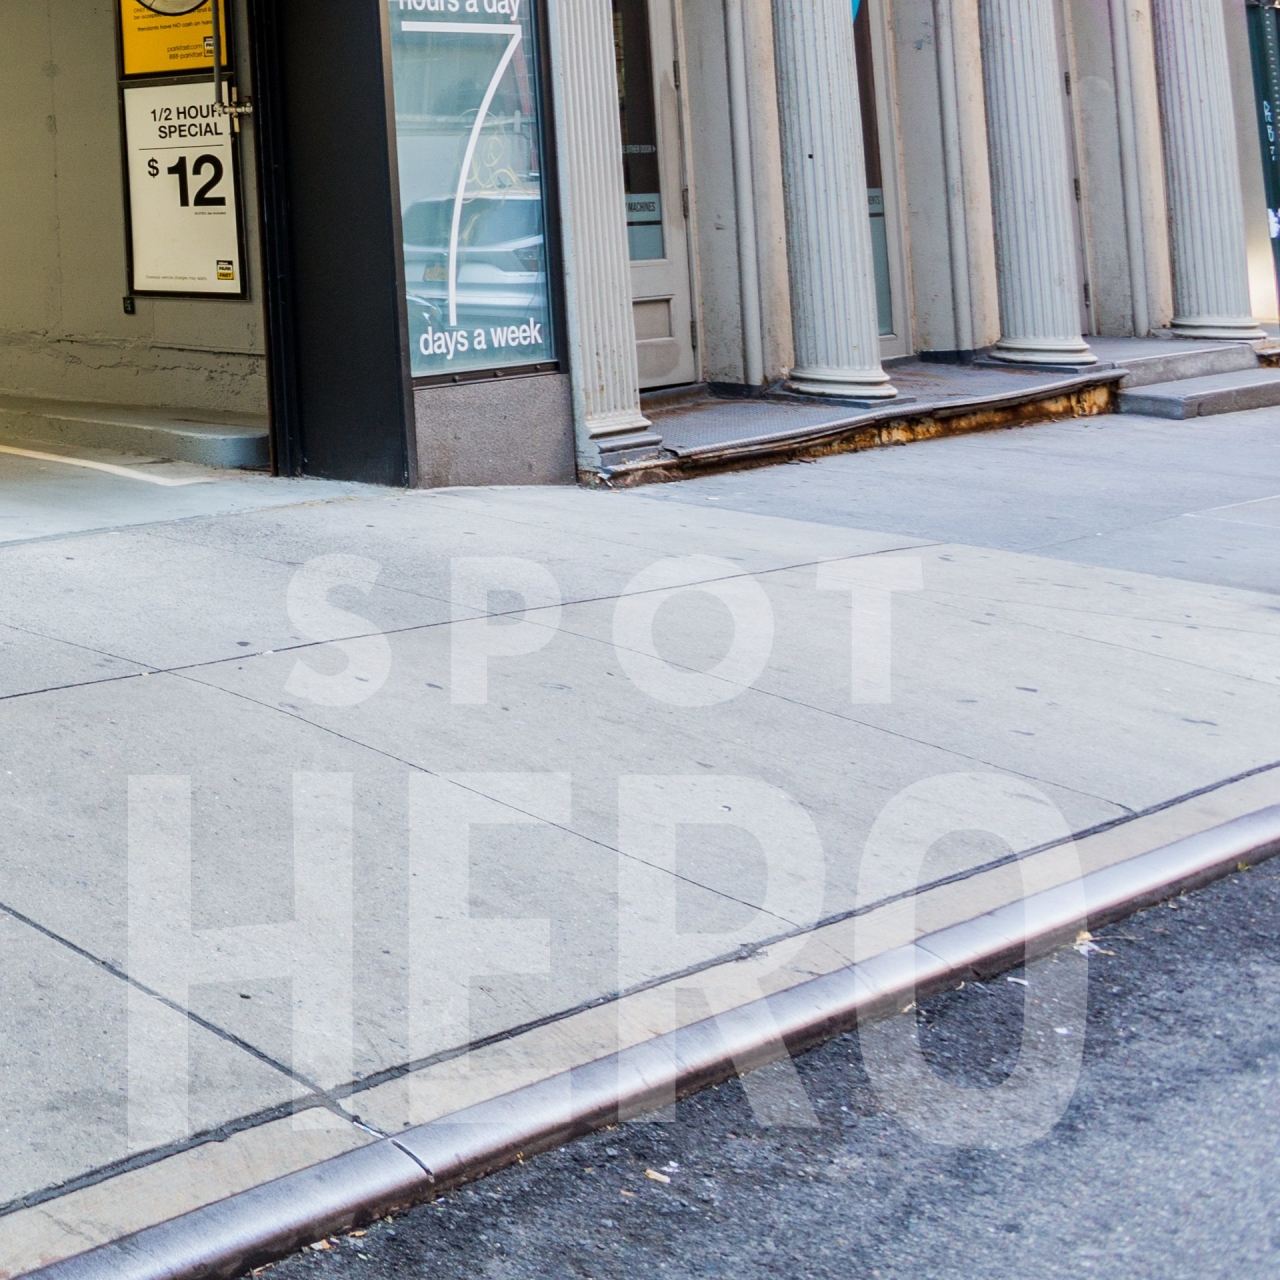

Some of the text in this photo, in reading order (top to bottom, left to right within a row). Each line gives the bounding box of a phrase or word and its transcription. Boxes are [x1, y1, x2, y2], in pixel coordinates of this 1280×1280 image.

[150, 107, 172, 122] 1/2
[158, 122, 223, 139] SPECIAL
[401, 20, 522, 327] 7
[419, 317, 543, 360] days a week
